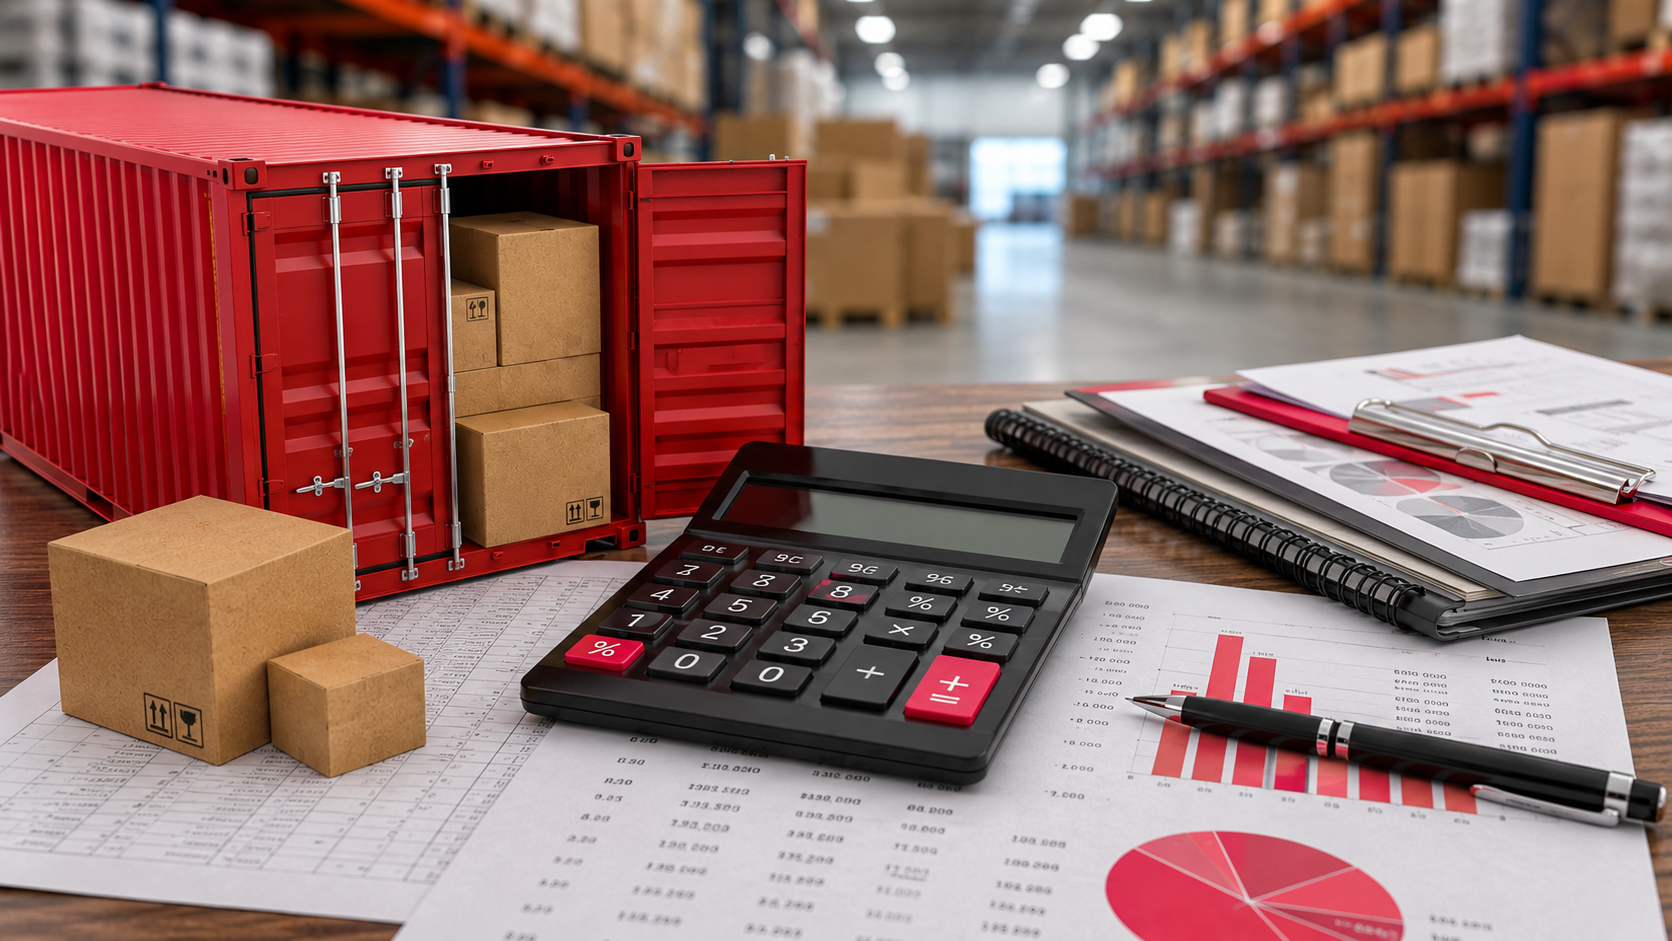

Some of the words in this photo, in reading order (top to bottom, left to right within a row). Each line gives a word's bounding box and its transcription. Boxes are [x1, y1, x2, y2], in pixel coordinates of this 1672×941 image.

[650, 588, 675, 601] 4
[830, 585, 853, 599] 8
[727, 598, 753, 612] 5
[908, 596, 935, 611] %
[627, 614, 645, 628] 1
[984, 606, 1012, 622] %
[700, 625, 727, 640] 2
[588, 641, 621, 657] %
[783, 637, 809, 653] 3
[966, 634, 996, 649] %
[674, 653, 700, 670] 0
[758, 666, 785, 683] 0
